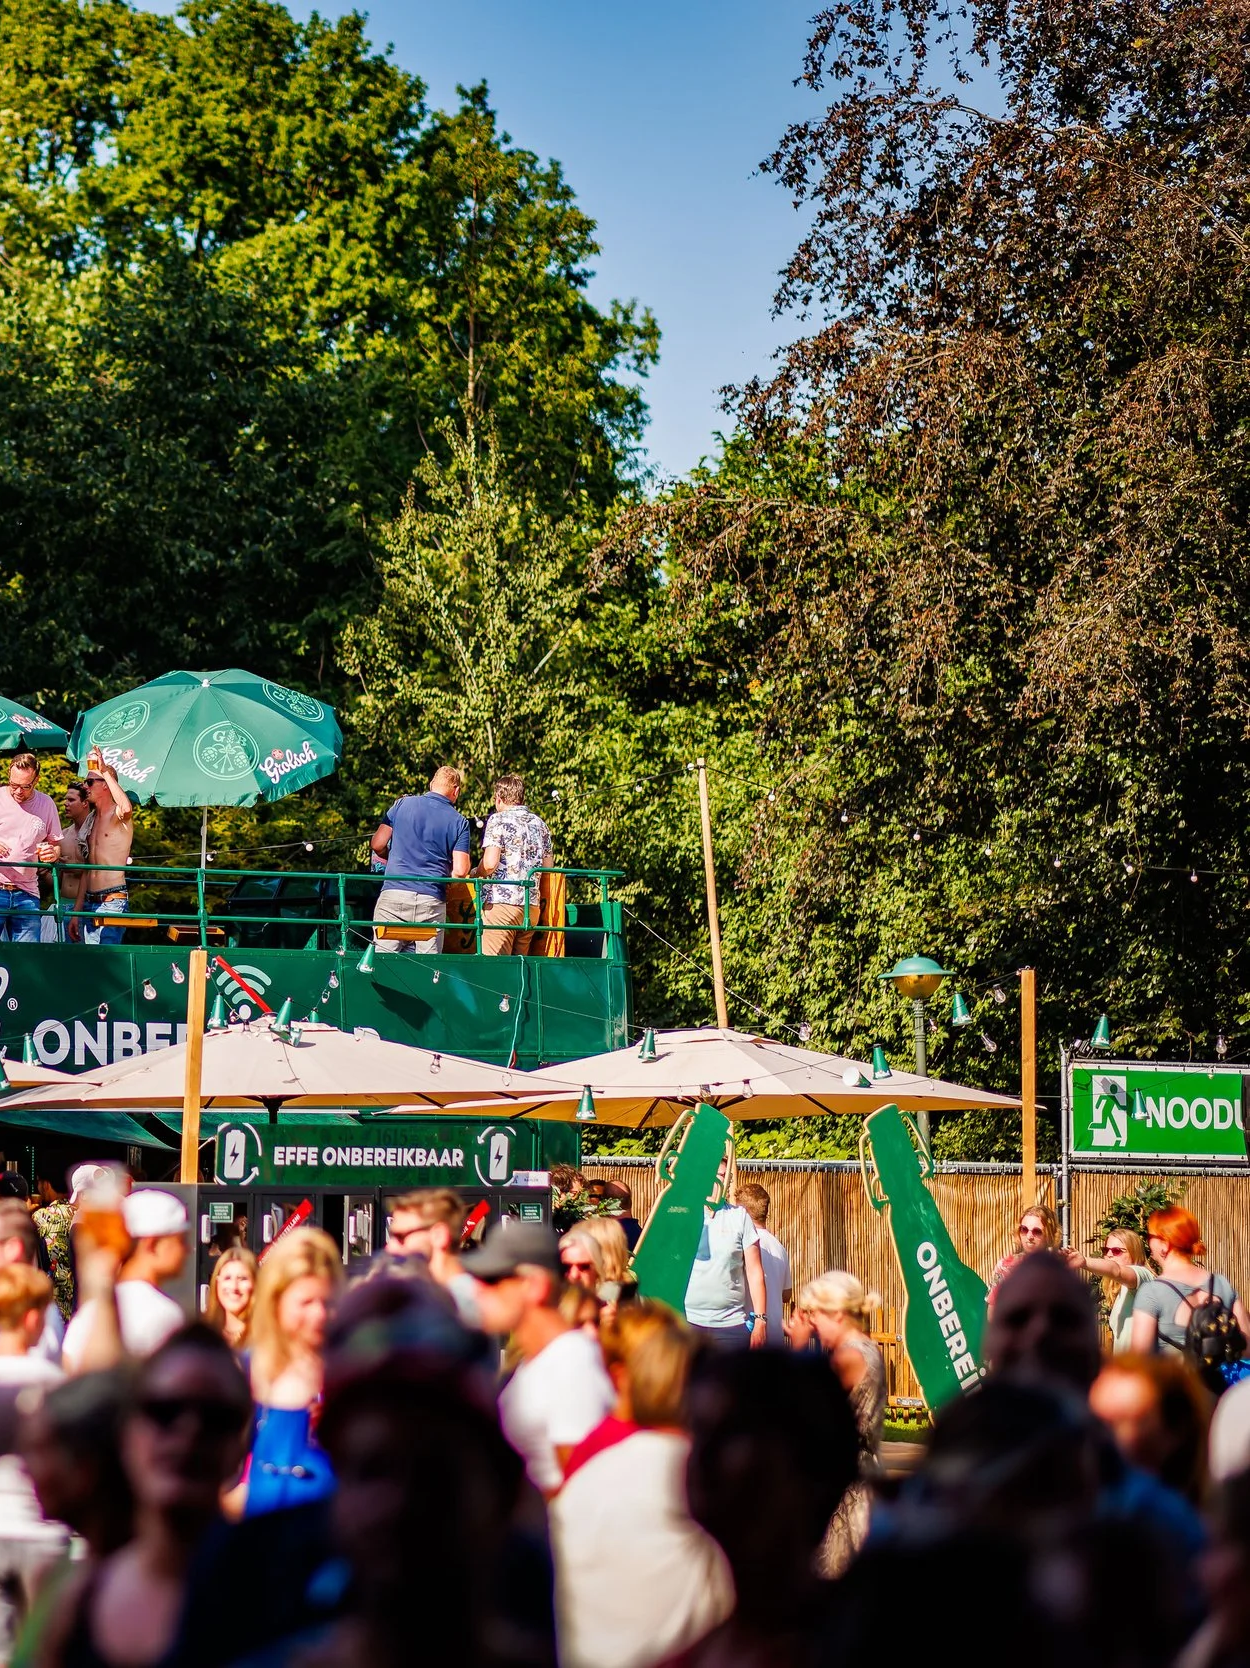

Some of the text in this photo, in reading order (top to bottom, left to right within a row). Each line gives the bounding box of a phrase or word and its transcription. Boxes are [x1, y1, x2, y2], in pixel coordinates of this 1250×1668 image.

[259, 741, 319, 784] Grolsch
[273, 1146, 464, 1168] EFFE ONBEREIKBAAR
